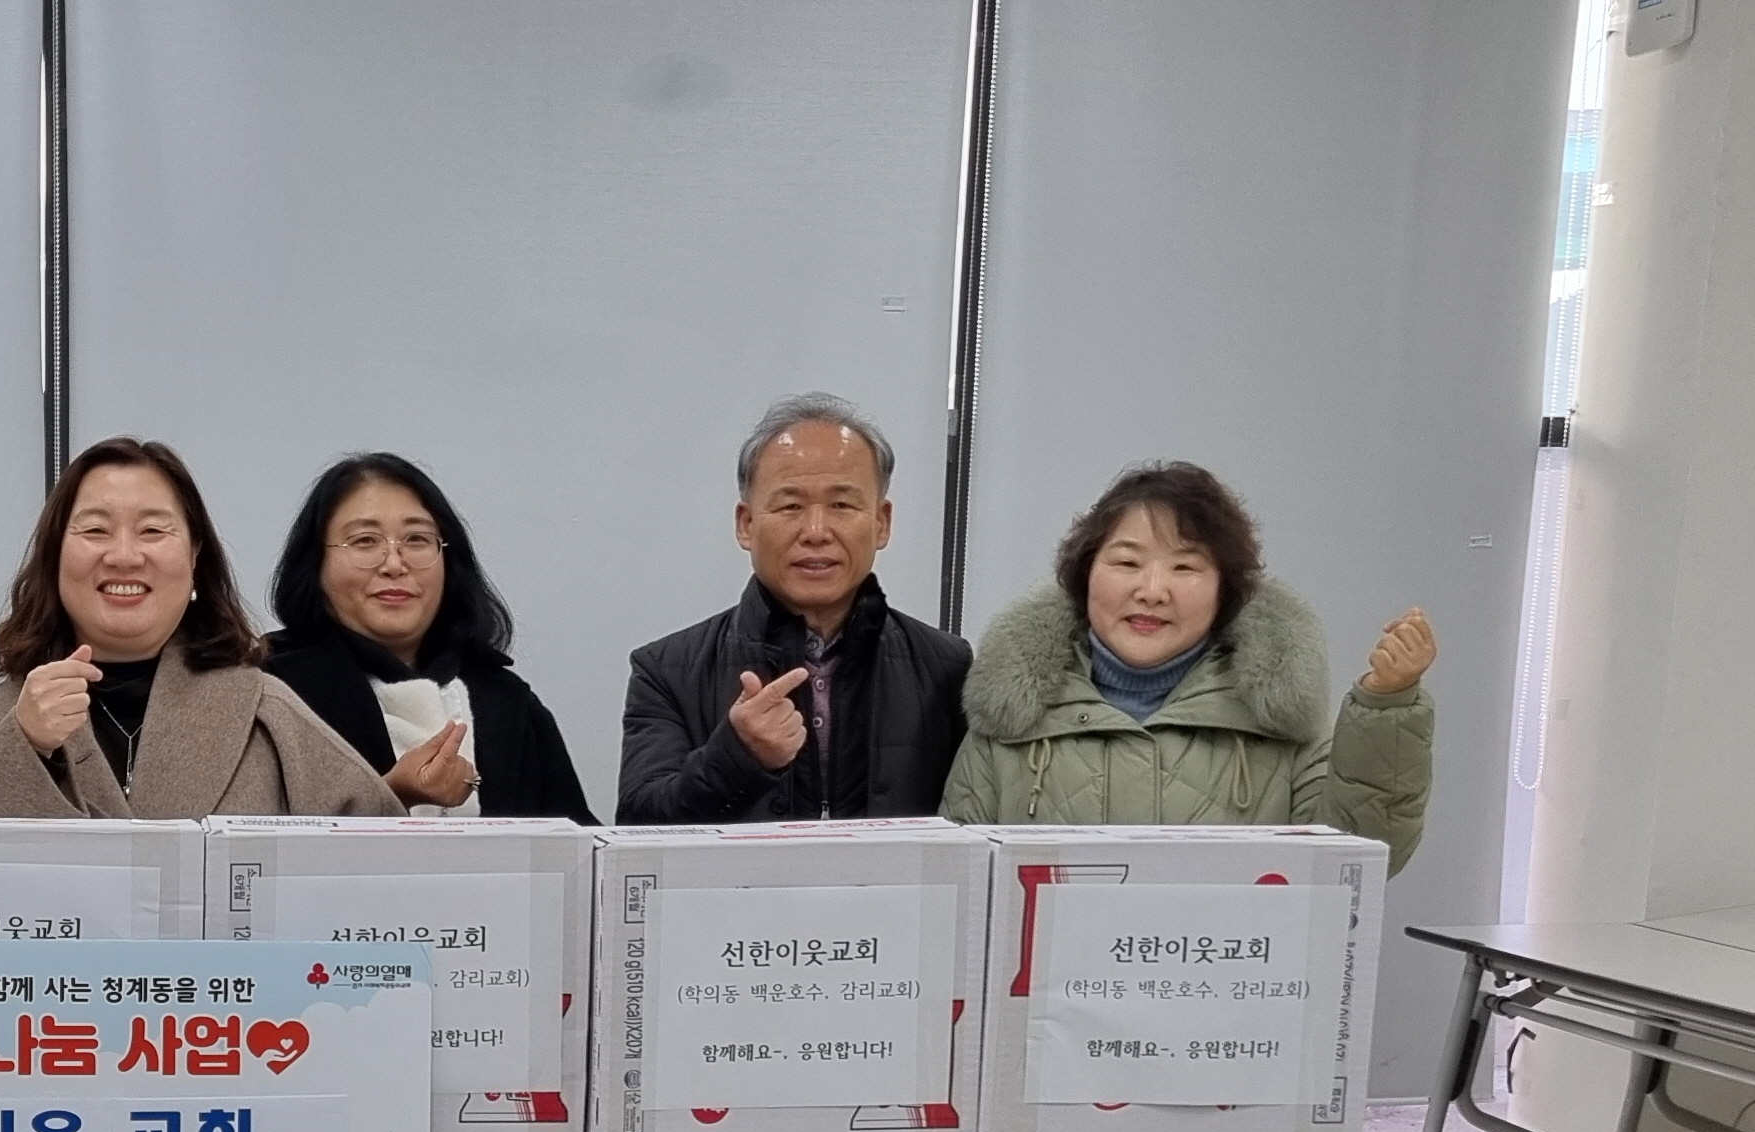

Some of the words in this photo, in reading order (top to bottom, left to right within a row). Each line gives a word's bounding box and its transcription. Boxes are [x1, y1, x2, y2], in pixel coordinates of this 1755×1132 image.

[720, 936, 879, 969] 선한이웃교회
[1108, 935, 1271, 965] 선한이웃교회
[332, 964, 412, 982] 사랑의열매
[44, 975, 93, 1003] 사는
[101, 975, 198, 1004] 청계동을
[207, 976, 256, 1004] 위한
[117, 1013, 243, 1077] 사업
[797, 1040, 894, 1062] 응원합니다!
[1184, 1039, 1280, 1060] 응원합니다!
